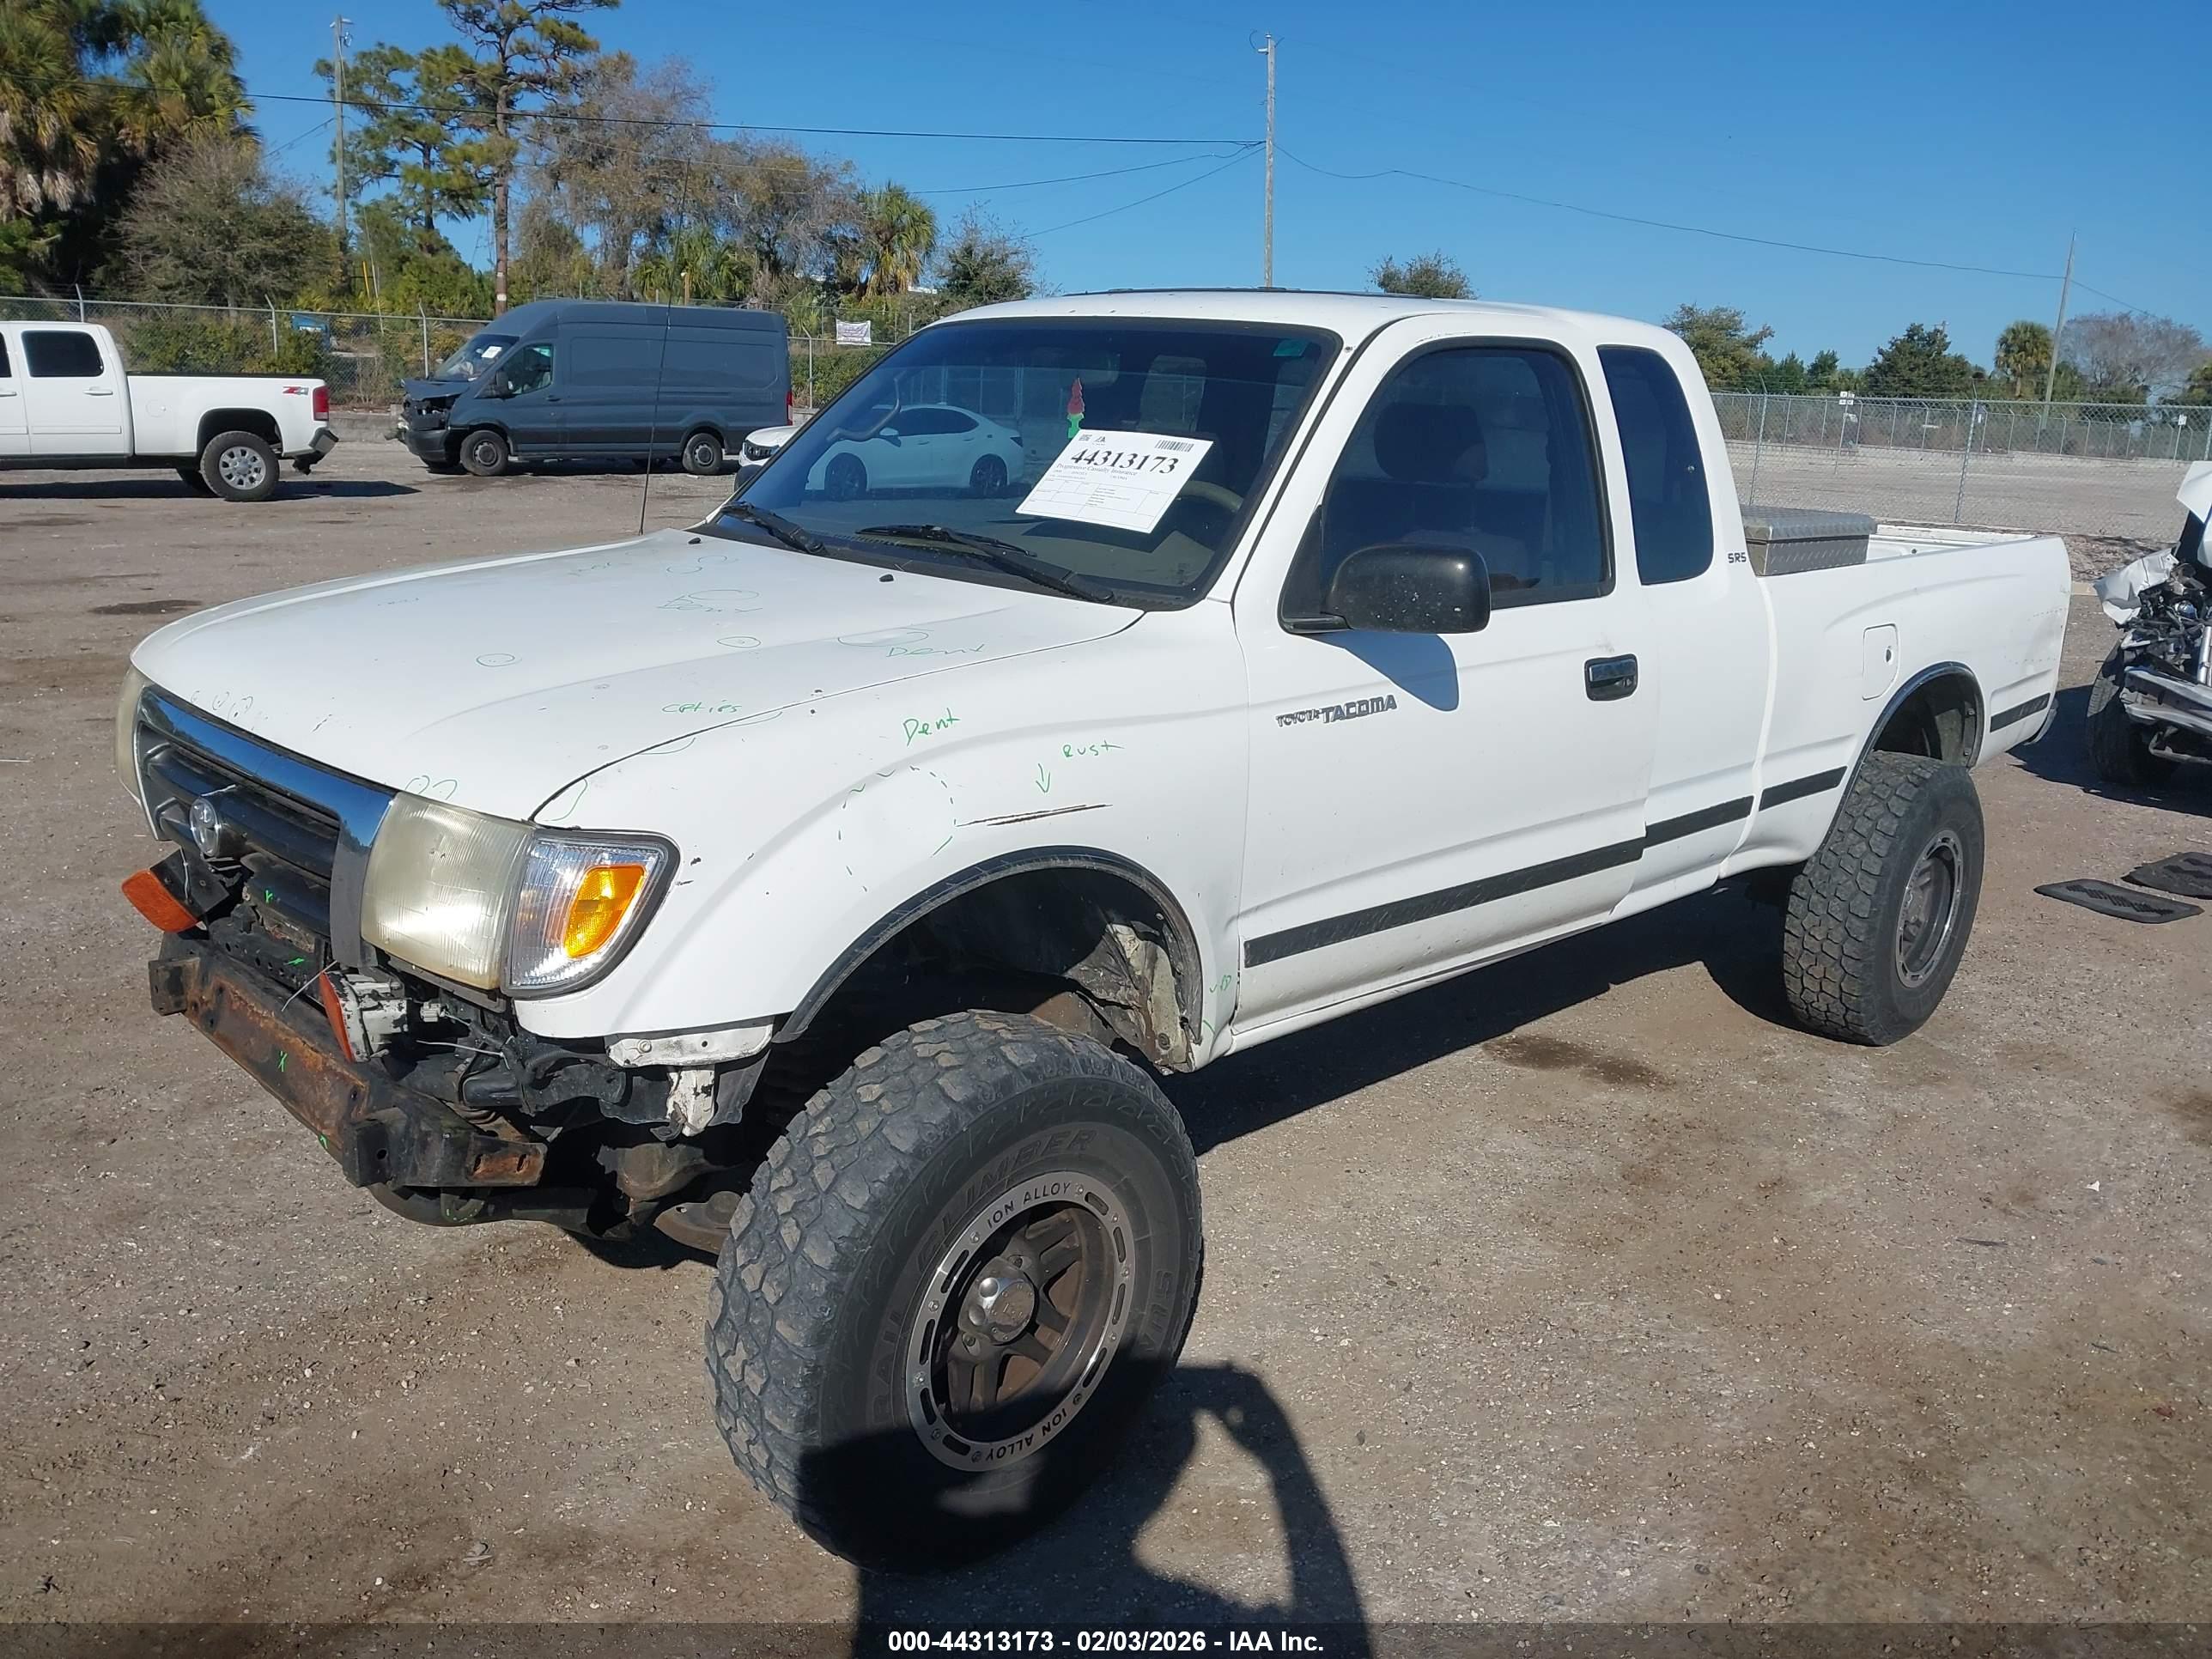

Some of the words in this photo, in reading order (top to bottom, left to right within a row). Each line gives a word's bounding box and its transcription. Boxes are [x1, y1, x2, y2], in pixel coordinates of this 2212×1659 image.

[1071, 448, 1179, 474] 44313173
[902, 707, 961, 746] Dent
[1275, 708, 1320, 728] TOYOTA
[1319, 695, 1398, 724] TACOMA
[988, 1201, 1014, 1229] ION
[1023, 1182, 1072, 1205] ALLOY
[1042, 1408, 1067, 1437] ION
[986, 1433, 1035, 1461] ALLOY
